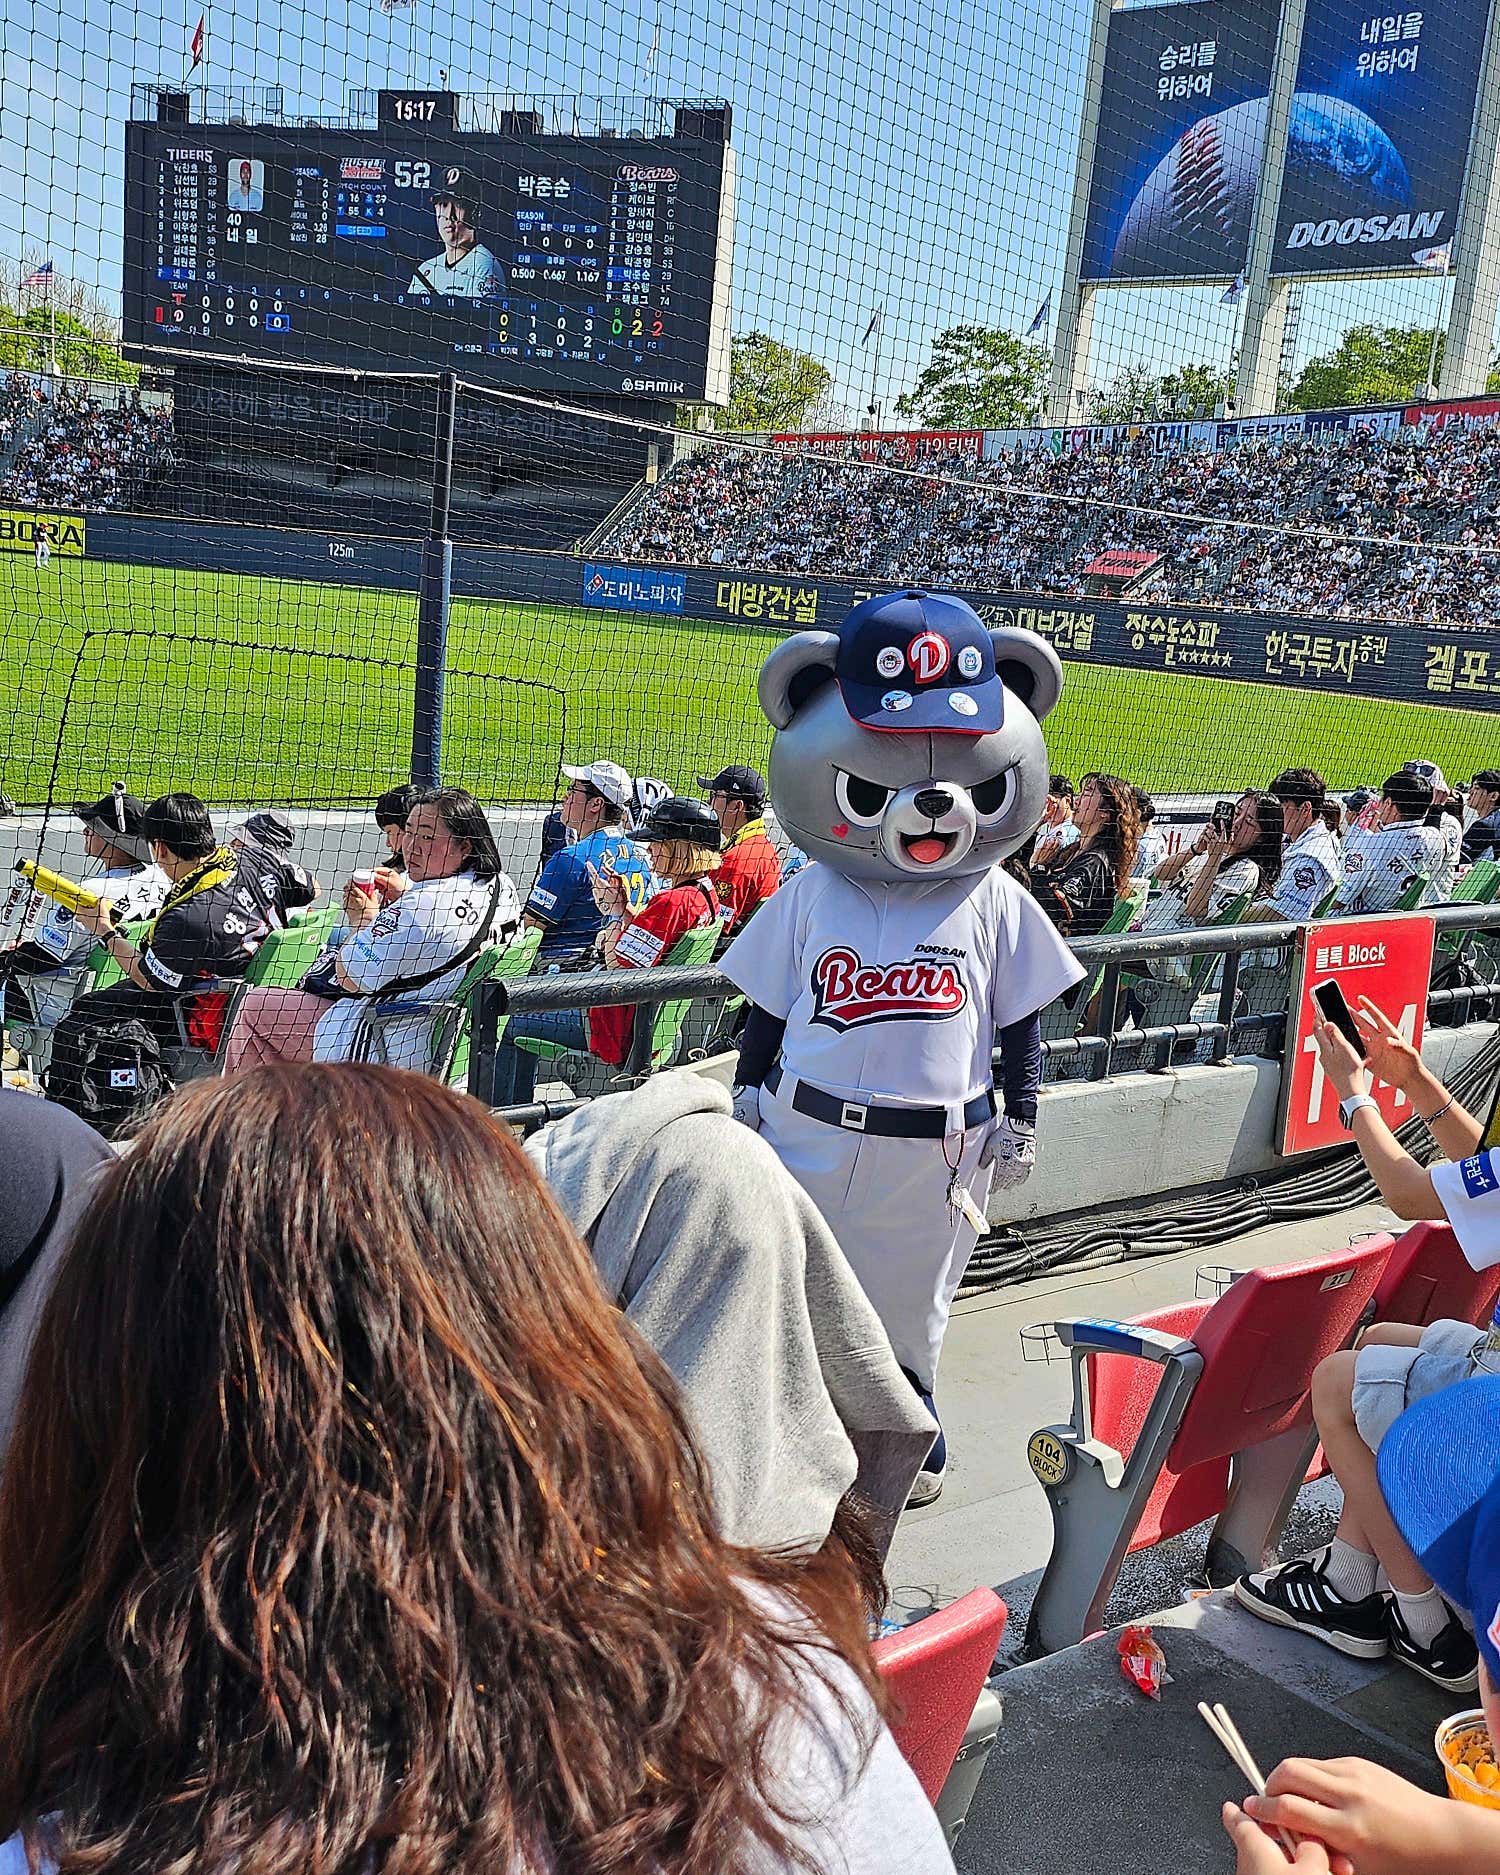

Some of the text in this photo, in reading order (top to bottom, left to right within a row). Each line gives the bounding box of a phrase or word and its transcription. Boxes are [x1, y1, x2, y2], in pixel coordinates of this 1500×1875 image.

[1360, 11, 1425, 44] 내일을
[1158, 41, 1218, 70] 승리를
[1356, 46, 1419, 78] 위하여
[1157, 73, 1214, 101] 위하여
[395, 100, 436, 122] 15:17
[166, 148, 214, 163] TIGERS
[323, 178, 329, 188] 2
[395, 161, 431, 188] 52
[322, 190, 329, 199] 0
[518, 175, 571, 198] 박준순
[322, 201, 328, 210] 0
[350, 193, 360, 202] 16
[628, 194, 655, 205] 케이브
[227, 213, 242, 226] 40
[322, 212, 328, 221] 0
[348, 207, 359, 216] 55
[516, 211, 544, 220] SEASON
[668, 209, 674, 217] C
[173, 222, 197, 232] 이우성
[347, 226, 372, 235] SPEED
[1286, 210, 1445, 249] DOOSAN
[543, 236, 550, 247] 0
[565, 237, 572, 248] 0
[587, 239, 594, 249] 0
[581, 258, 597, 266] OPS
[511, 268, 600, 282] 0.500 0.667 1.167
[299, 289, 305, 298] 5
[324, 291, 330, 299] 6
[398, 295, 404, 303] 9
[421, 296, 430, 305] 10
[448, 298, 454, 306] 11
[472, 300, 481, 308] 12
[530, 303, 536, 311] H
[588, 306, 593, 314] B
[660, 297, 670, 305] 74
[202, 296, 210, 308] 0
[226, 297, 234, 310] 0
[249, 299, 258, 311] 0
[274, 300, 282, 312] 0
[500, 313, 508, 326] 0
[531, 315, 536, 328] 1
[557, 317, 566, 329] 0
[584, 319, 593, 331] 3
[614, 307, 662, 318] B S O
[202, 312, 210, 324] 0
[225, 314, 234, 325] 0
[249, 315, 258, 327] 0
[273, 316, 281, 328] 0
[528, 332, 537, 345] 3
[556, 334, 565, 346] 0
[583, 336, 592, 348] 2
[612, 319, 663, 337] 0 2 2
[634, 380, 684, 393] SAMIK
[328, 541, 355, 558] 125m
[602, 581, 683, 606] 도미노피자
[717, 581, 818, 624] 대방건설
[1126, 613, 1221, 666] 장수돌소파
[907, 632, 950, 685] D
[914, 944, 966, 959] DOOSAN
[1316, 942, 1386, 969] 블록 Block
[809, 946, 967, 1018] Bears
[1038, 1437, 1061, 1463] 104
[1033, 1454, 1058, 1480] BLOCK
